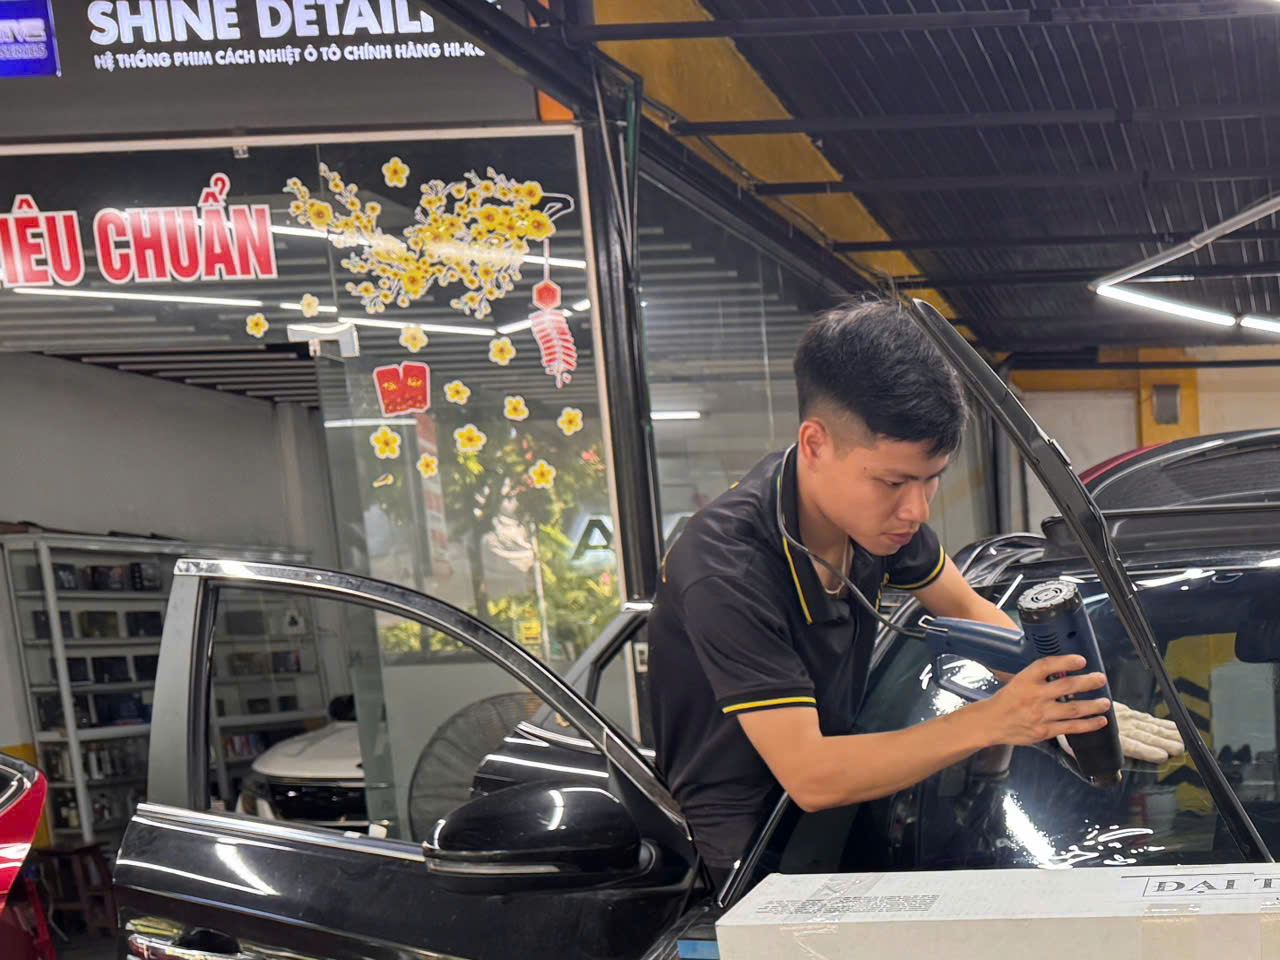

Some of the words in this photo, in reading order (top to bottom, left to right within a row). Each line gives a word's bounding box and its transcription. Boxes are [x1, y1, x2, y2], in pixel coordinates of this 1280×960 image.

[87, 0, 241, 45] SHINE
[94, 51, 115, 72] HỆ
[116, 48, 171, 69] THỐNG
[174, 50, 213, 67] PHIM
[215, 47, 256, 65] CÁCH
[259, 45, 301, 65] NHIỆT
[304, 44, 318, 62] Ô
[320, 43, 342, 61] TÔ
[344, 42, 392, 60] CHÍNH
[93, 172, 278, 284] CHUẨN
[1152, 878, 1236, 894] ĐẠI
